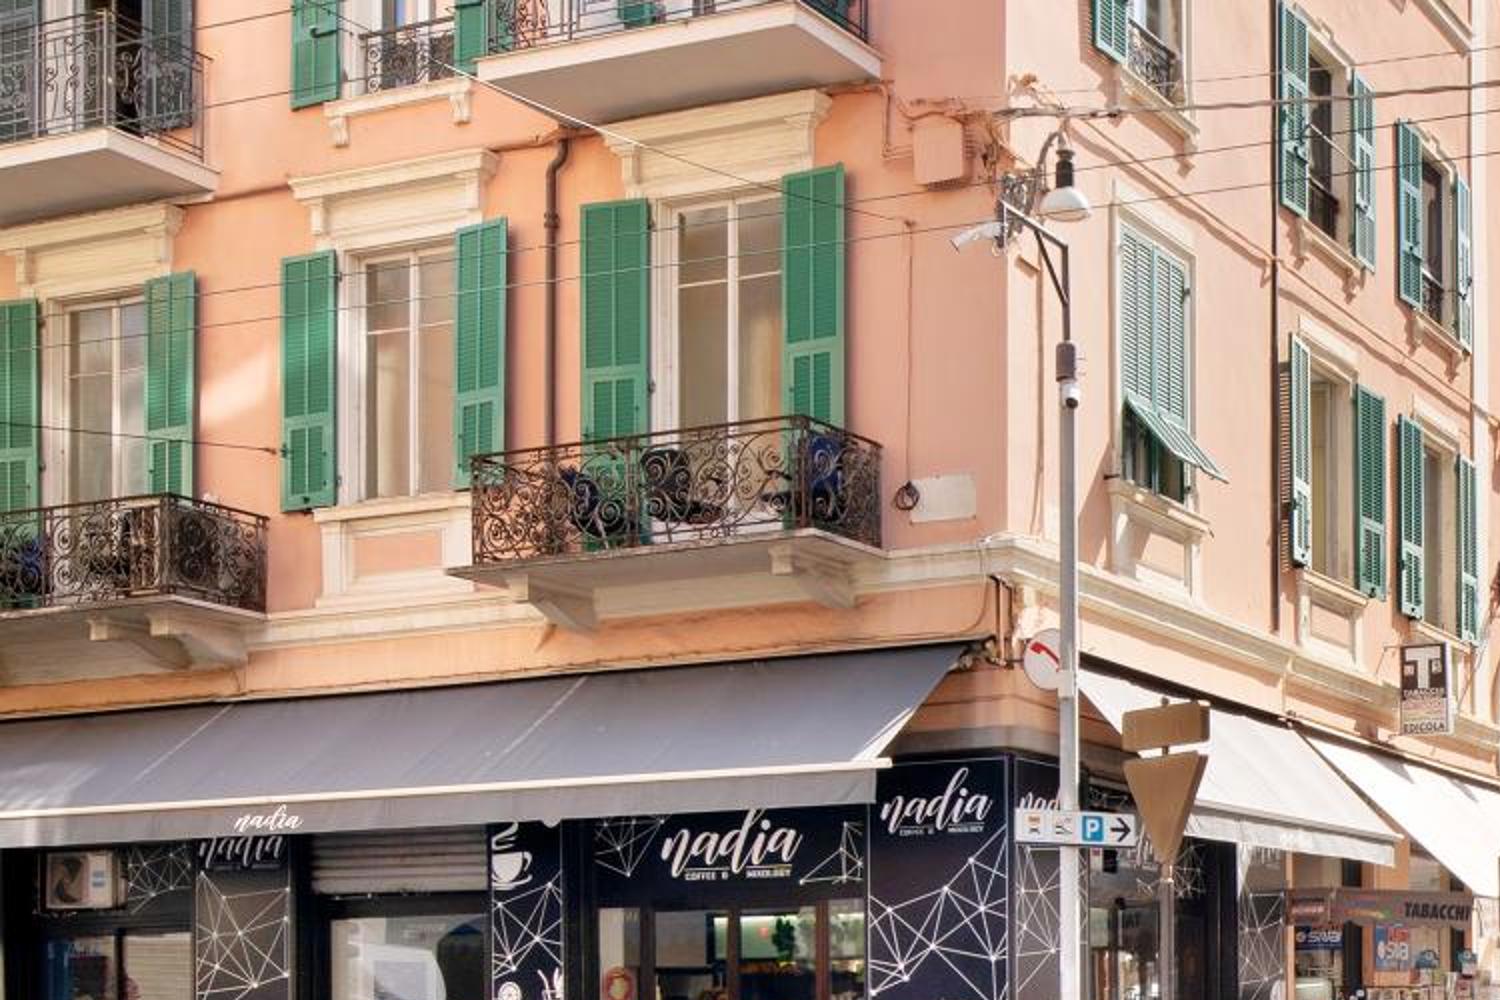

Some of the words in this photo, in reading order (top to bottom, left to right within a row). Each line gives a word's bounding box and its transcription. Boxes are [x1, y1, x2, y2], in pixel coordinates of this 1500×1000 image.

[1403, 722, 1445, 734] EDICOLA
[880, 766, 993, 835] nadia
[233, 803, 304, 833] nadia
[660, 807, 804, 878] nadia
[1404, 901, 1472, 922] TABACCHI
